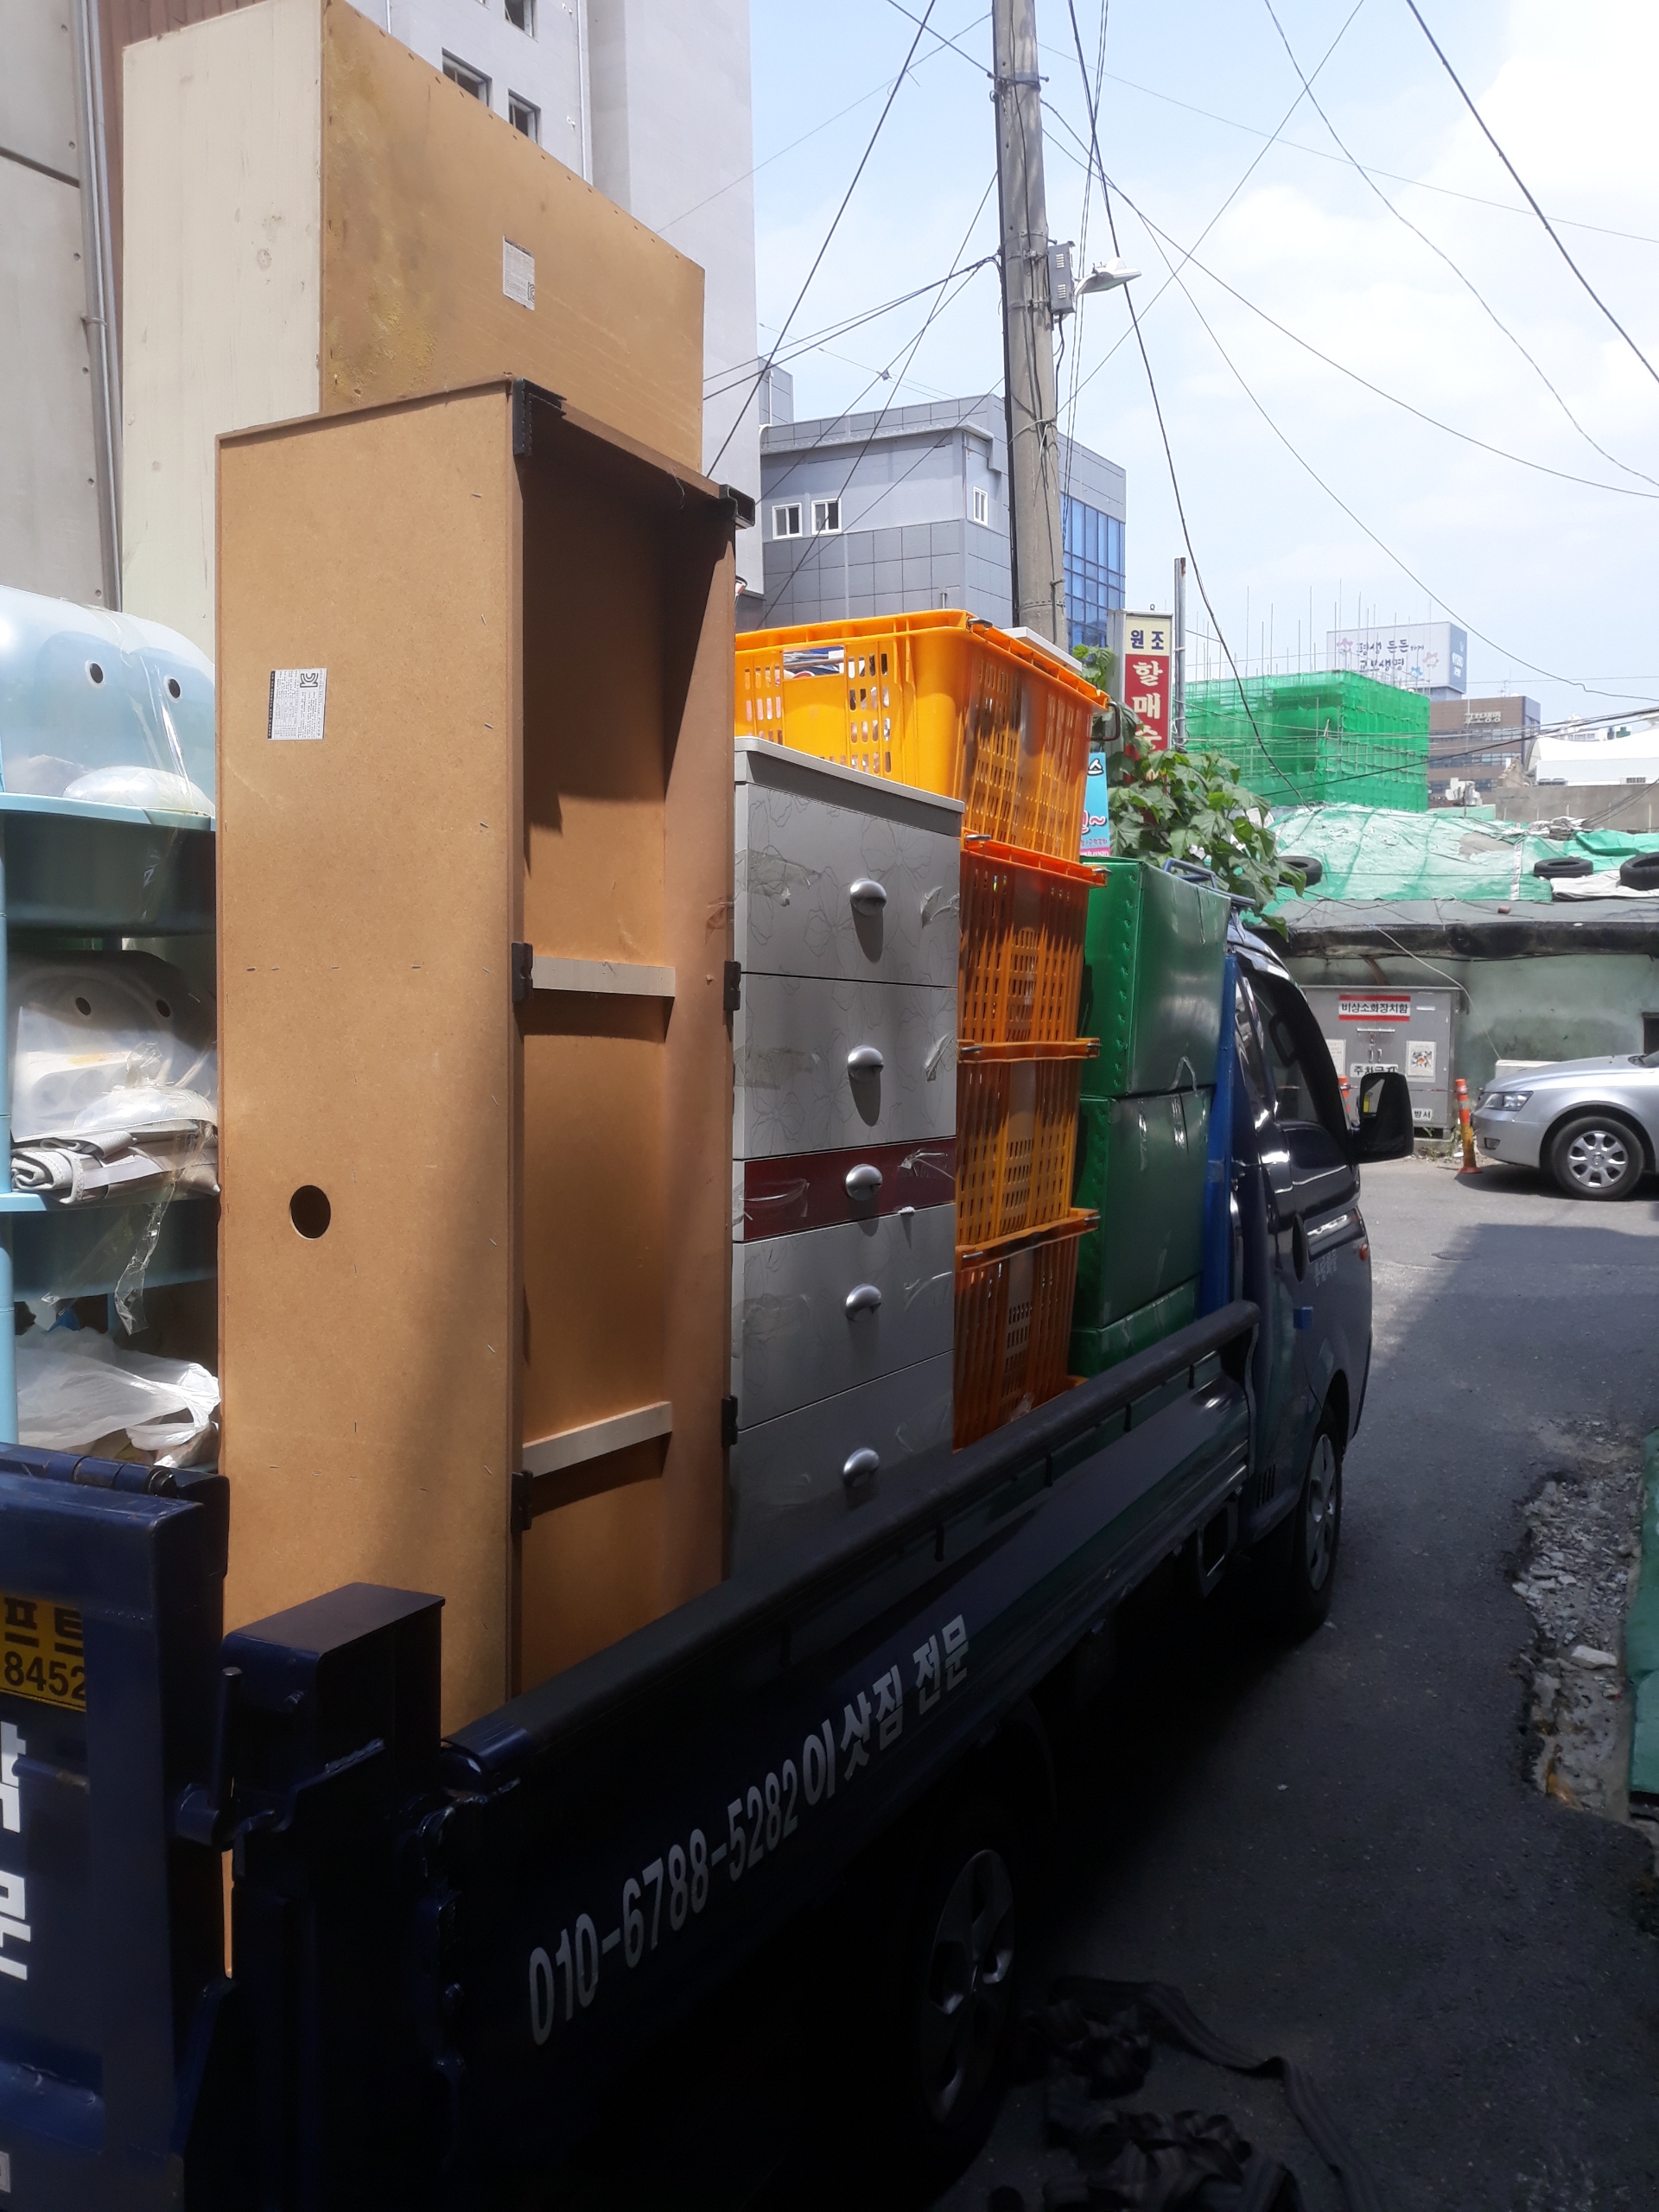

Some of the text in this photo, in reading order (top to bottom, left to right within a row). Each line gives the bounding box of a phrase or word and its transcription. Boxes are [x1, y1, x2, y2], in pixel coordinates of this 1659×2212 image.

[1130, 630, 1165, 651] 원조
[1341, 1002, 1408, 1014] 비상소화장치함
[4, 1651, 85, 1700] 8452
[528, 1614, 969, 2046] 010-6788-5282 이삿짐 전문
